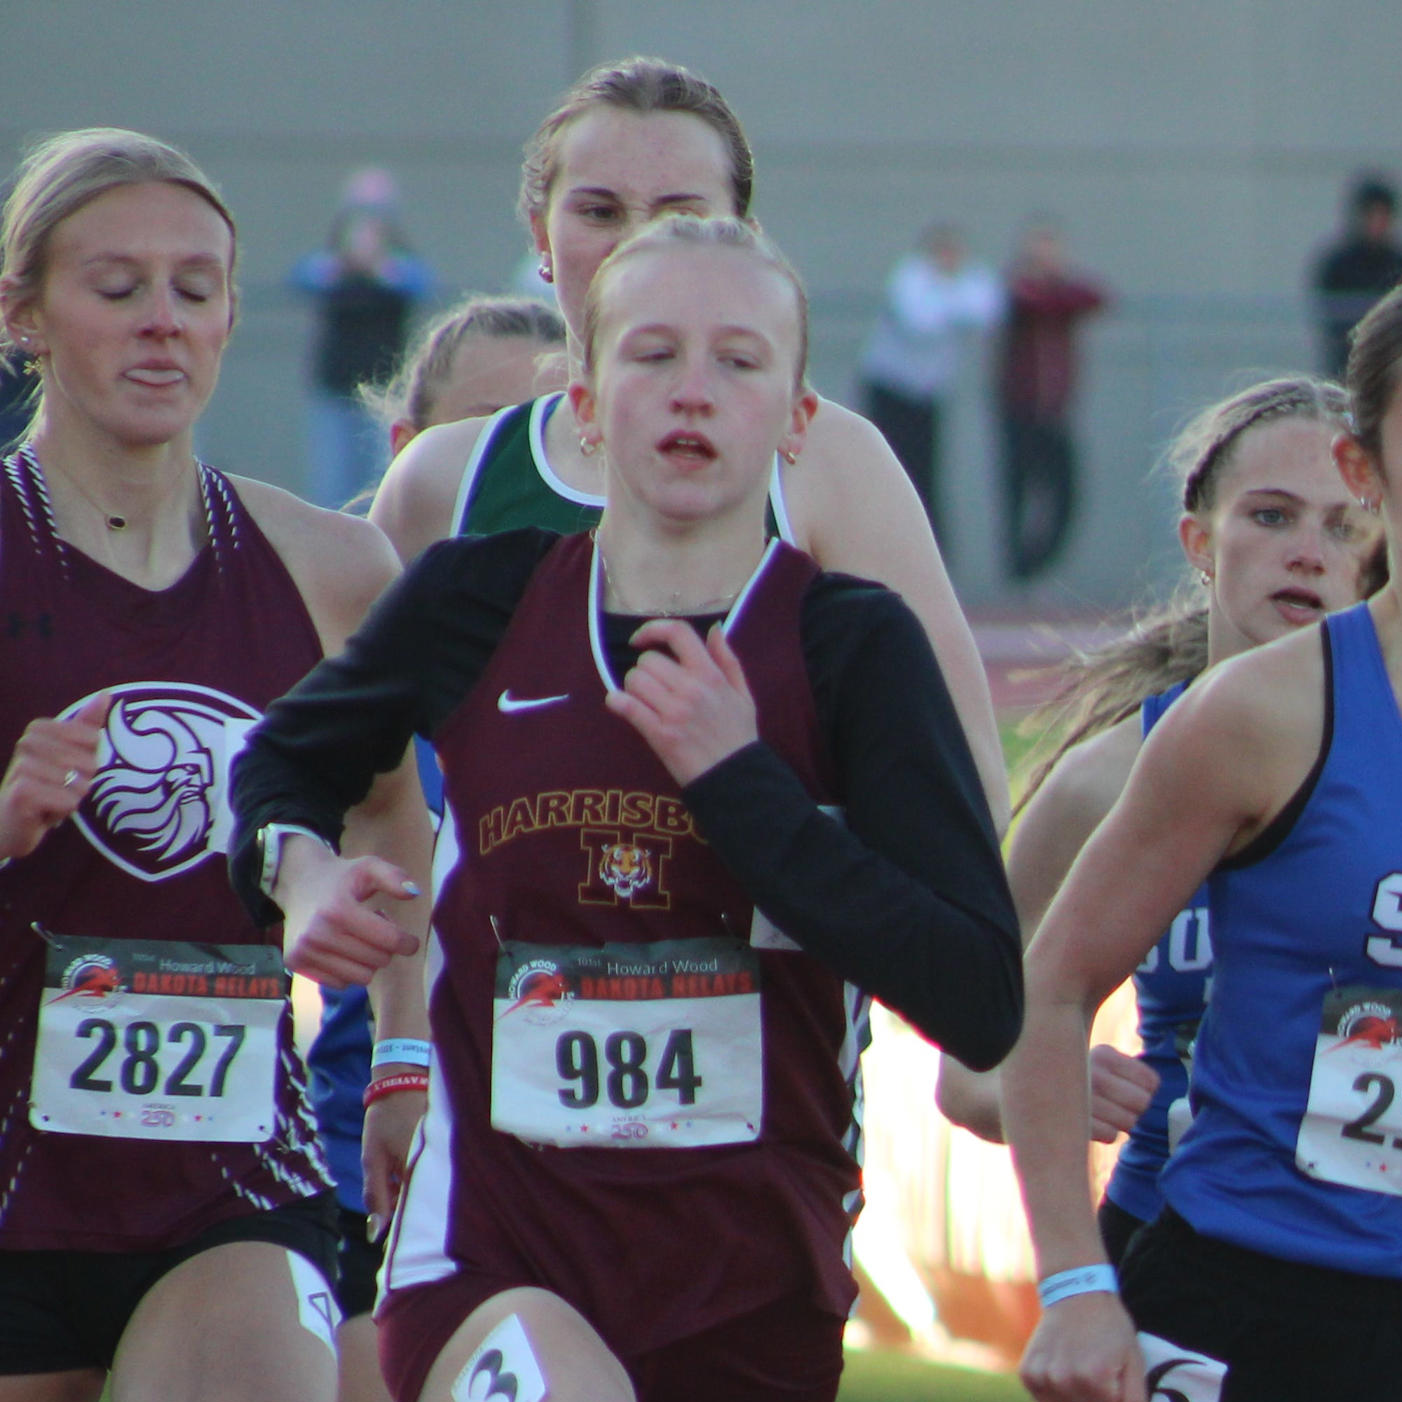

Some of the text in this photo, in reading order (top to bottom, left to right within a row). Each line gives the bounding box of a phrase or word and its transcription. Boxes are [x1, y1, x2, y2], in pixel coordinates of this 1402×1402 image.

[479, 789, 708, 856] HARRISB
[160, 960, 255, 976] Howard Wood
[607, 961, 668, 976] Howard
[672, 958, 719, 974] Wood
[134, 971, 280, 997] DAKOTA RELAYS
[580, 977, 665, 1000] DAKOTA
[672, 971, 756, 998] RELAYS
[70, 1017, 247, 1099] 2827
[555, 1028, 702, 1110] 984
